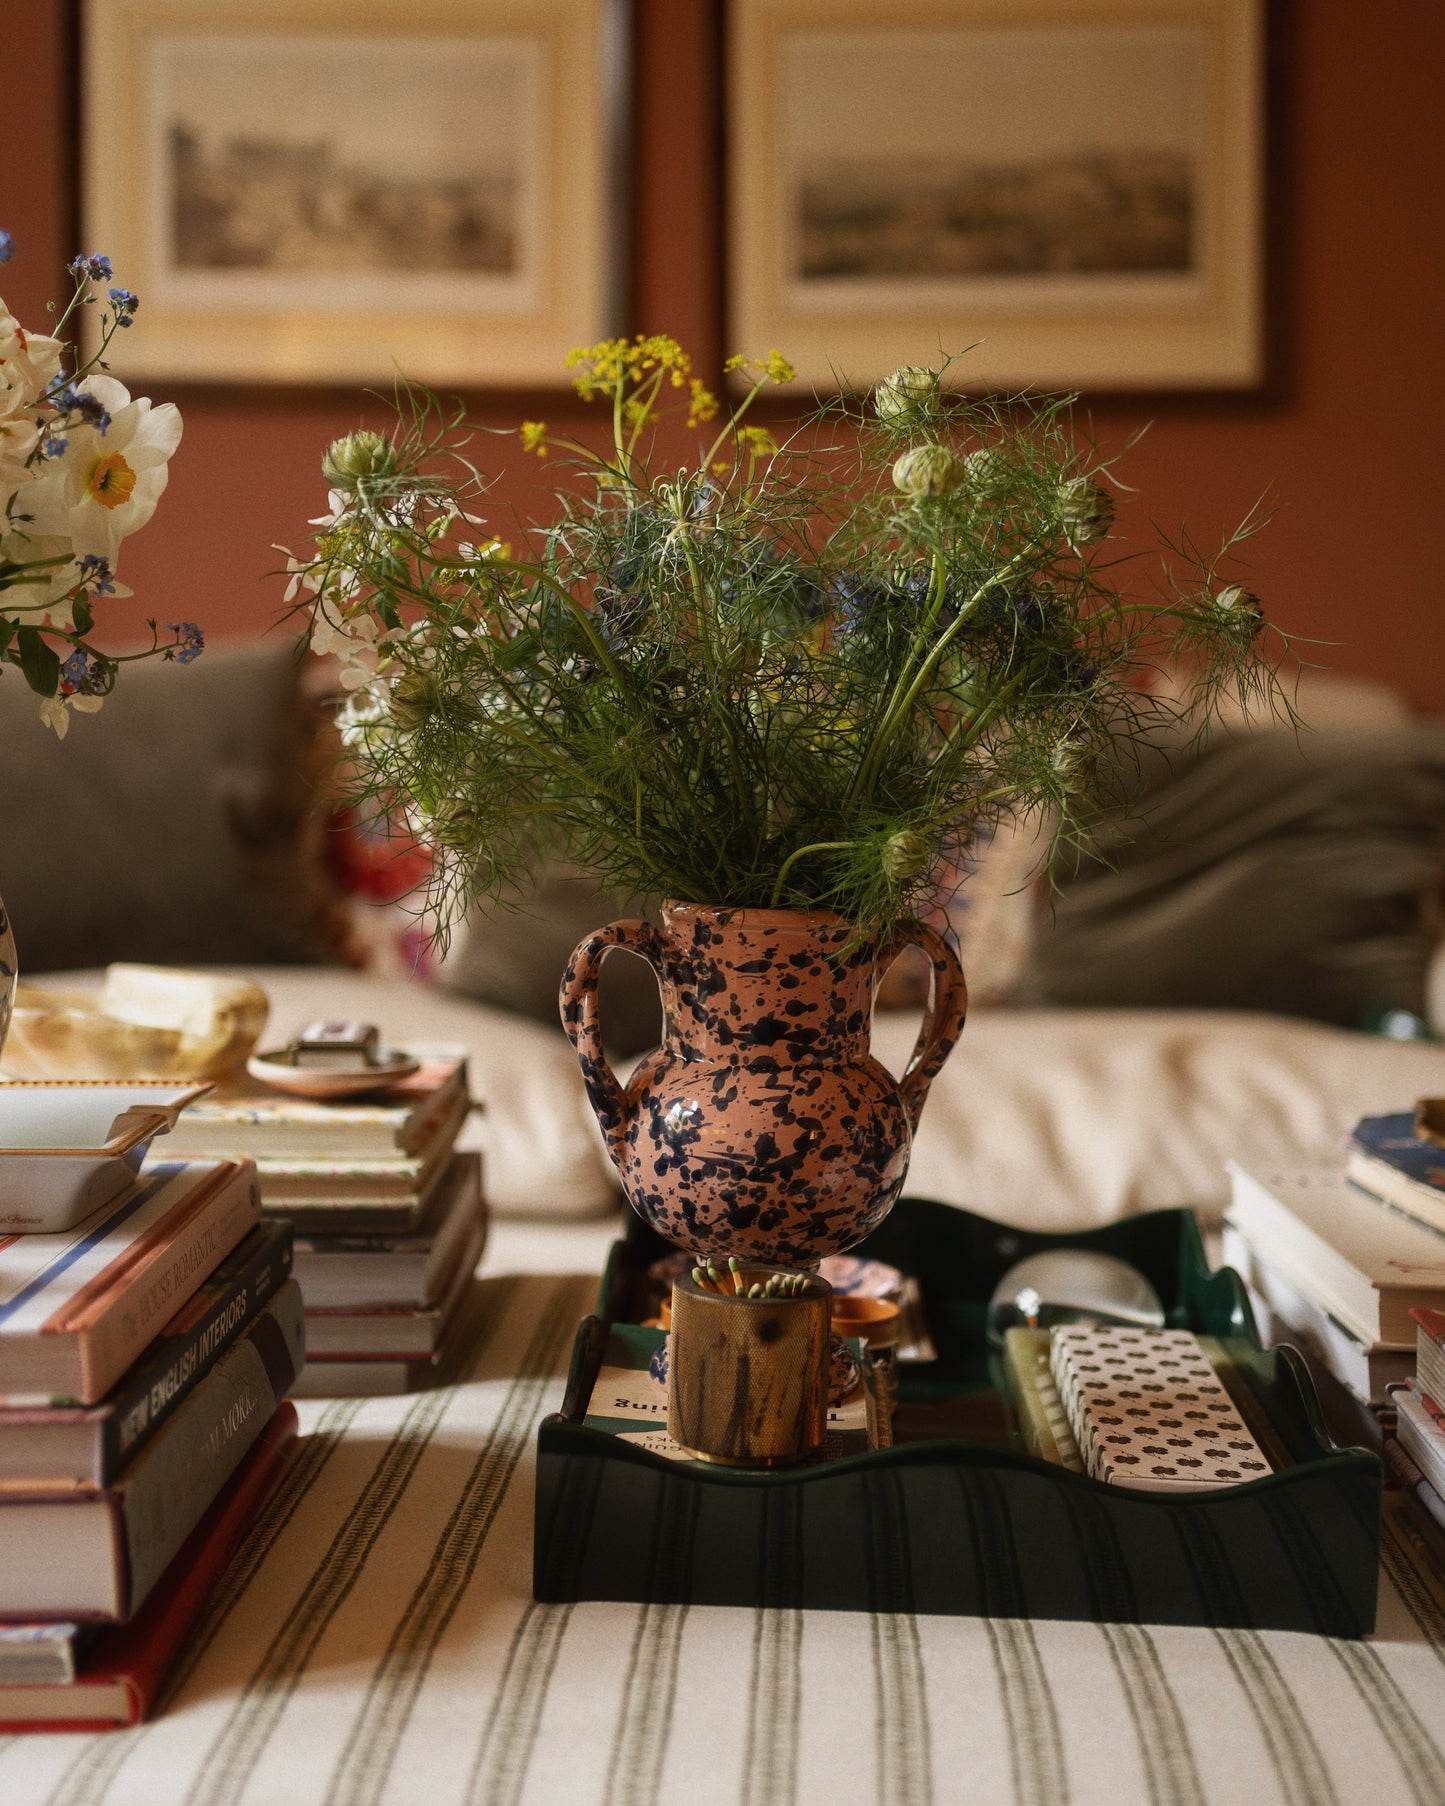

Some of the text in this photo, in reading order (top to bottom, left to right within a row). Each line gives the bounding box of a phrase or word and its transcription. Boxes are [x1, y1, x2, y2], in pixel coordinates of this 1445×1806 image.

[172, 1223, 216, 1290] ROMANTIC
[151, 1341, 197, 1419] ENGLISH
[199, 1288, 247, 1363] INTERIORS
[613, 1398, 667, 1413] ing
